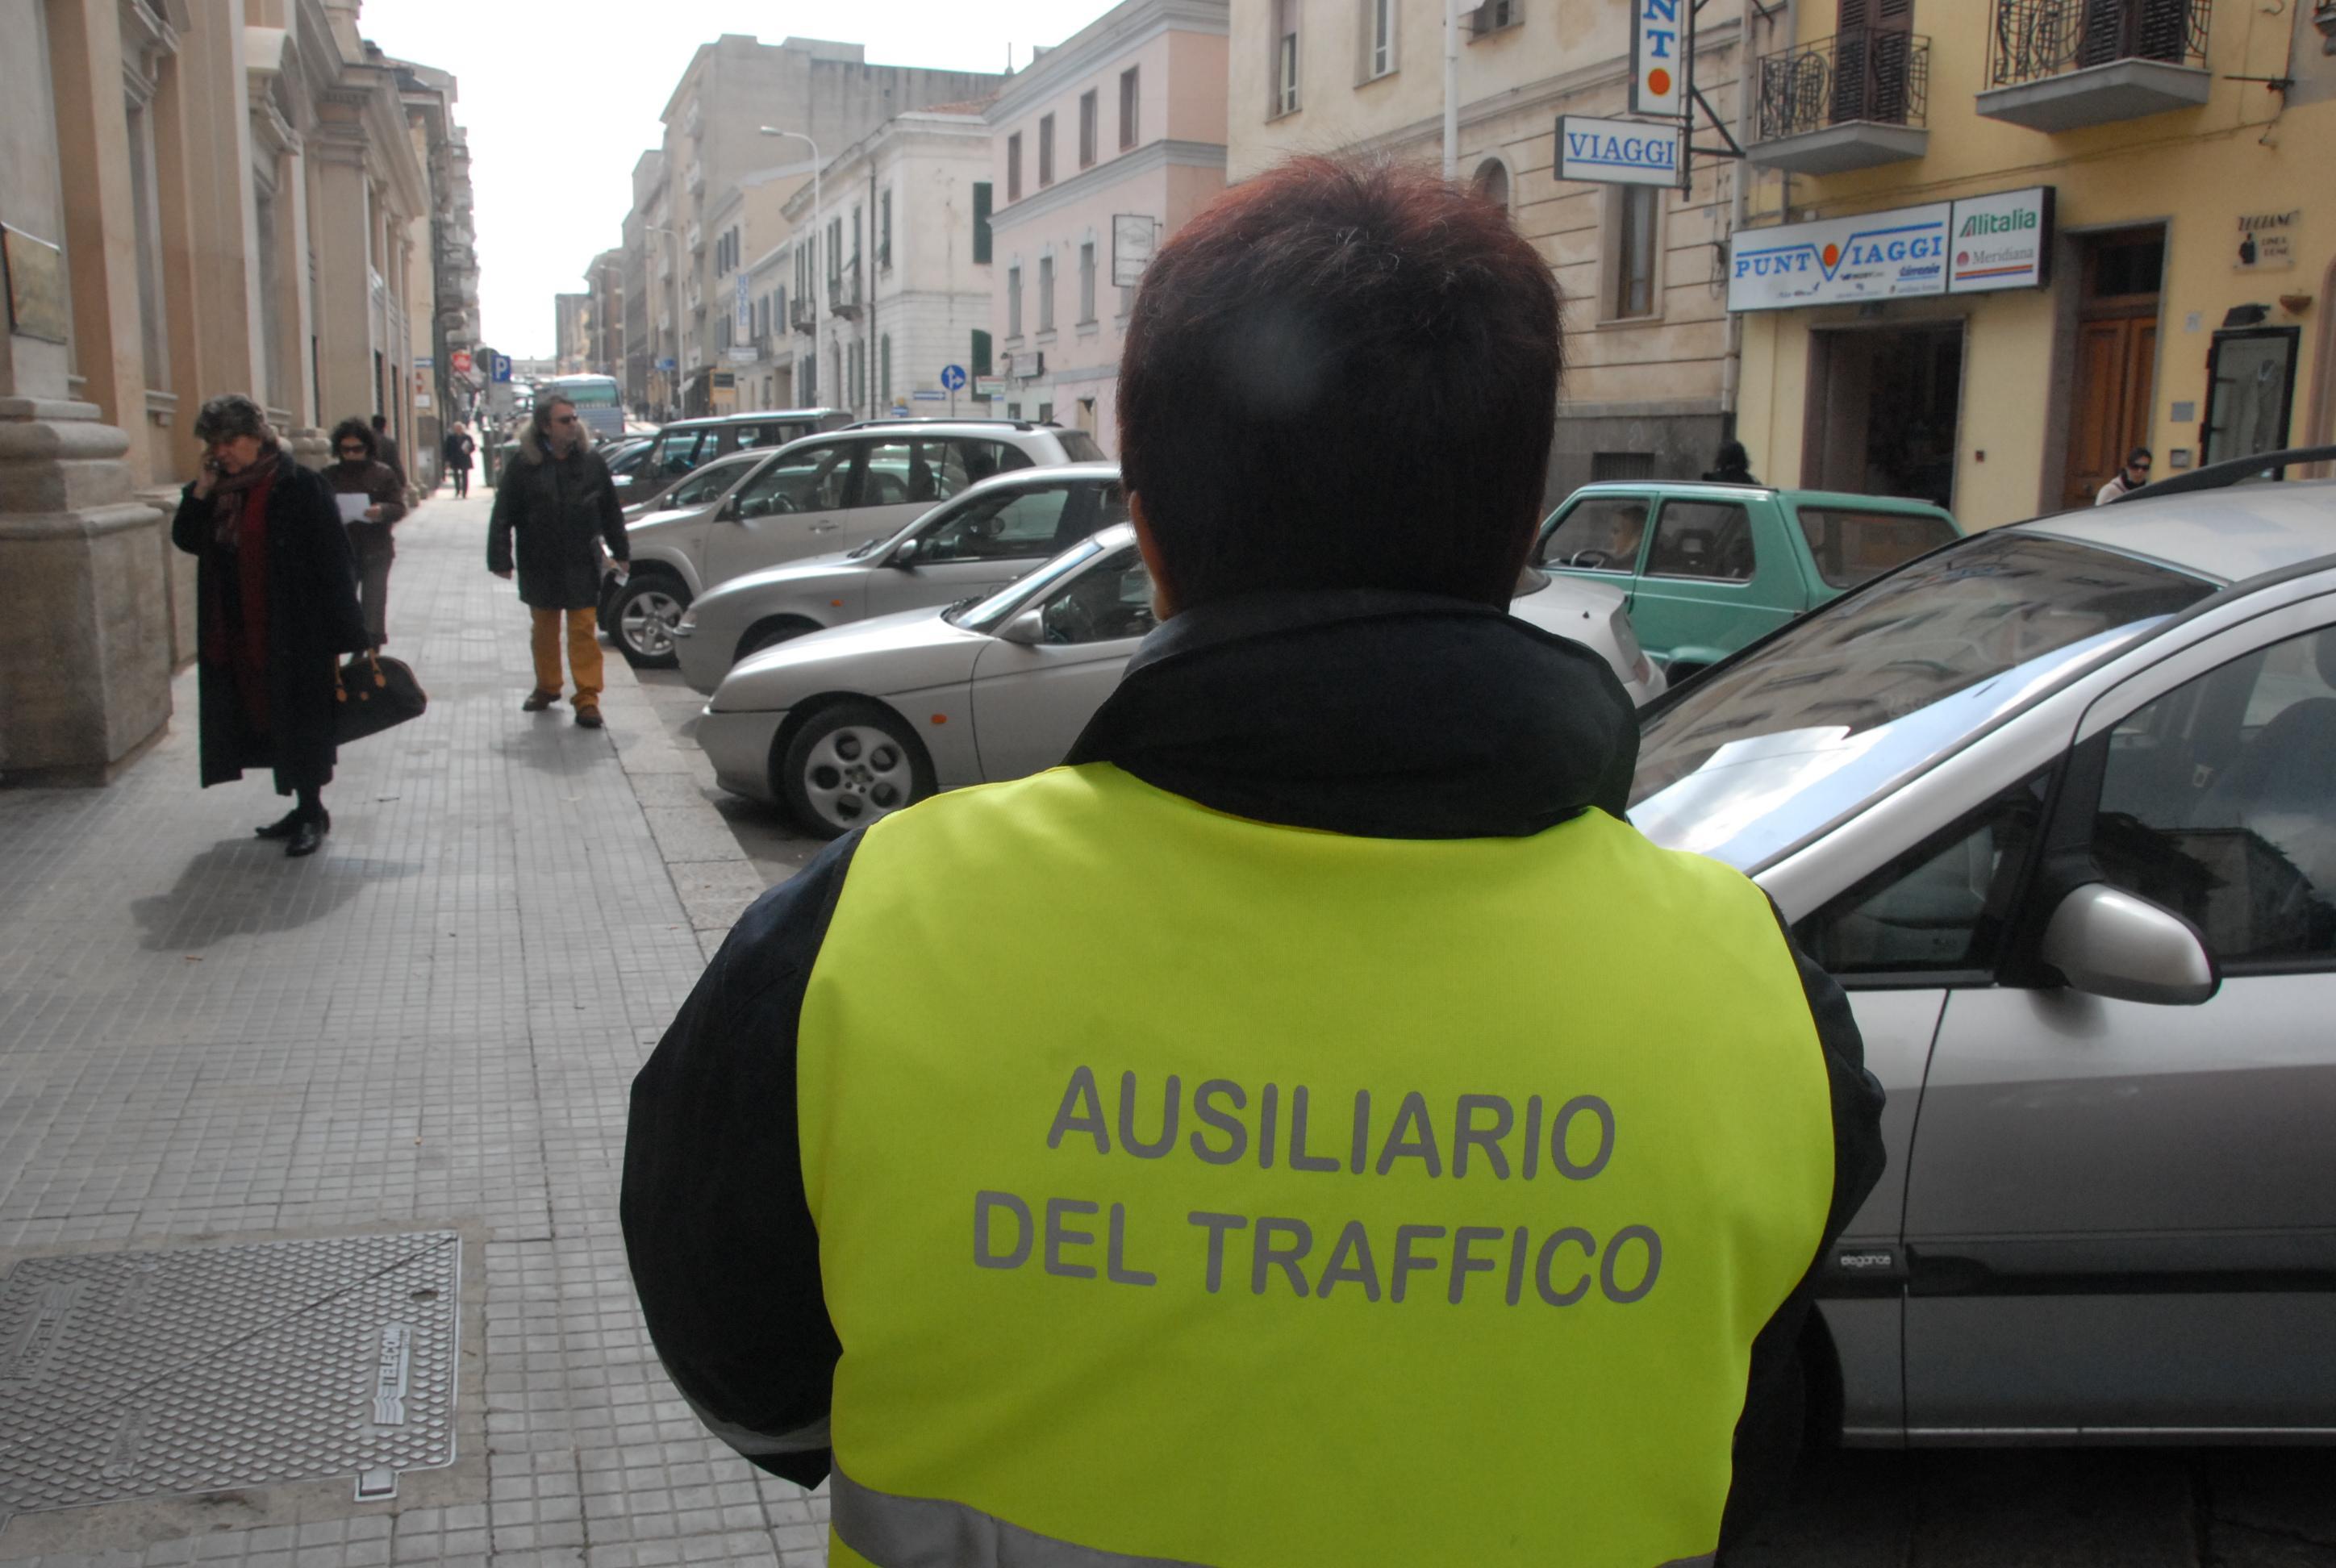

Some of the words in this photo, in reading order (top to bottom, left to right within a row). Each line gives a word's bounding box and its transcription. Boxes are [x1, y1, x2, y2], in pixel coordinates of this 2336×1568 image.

[1566, 132, 1675, 165] VIAGGI
[1958, 208, 2037, 238] Alitalia
[1972, 248, 2034, 265] Meridiana
[495, 357, 507, 379] P
[1046, 1065, 1616, 1181] AUSILIARIO
[973, 1190, 1158, 1287] DEL
[1187, 1211, 1662, 1307] TRAFFICO
[379, 1328, 401, 1386] TELECOM
